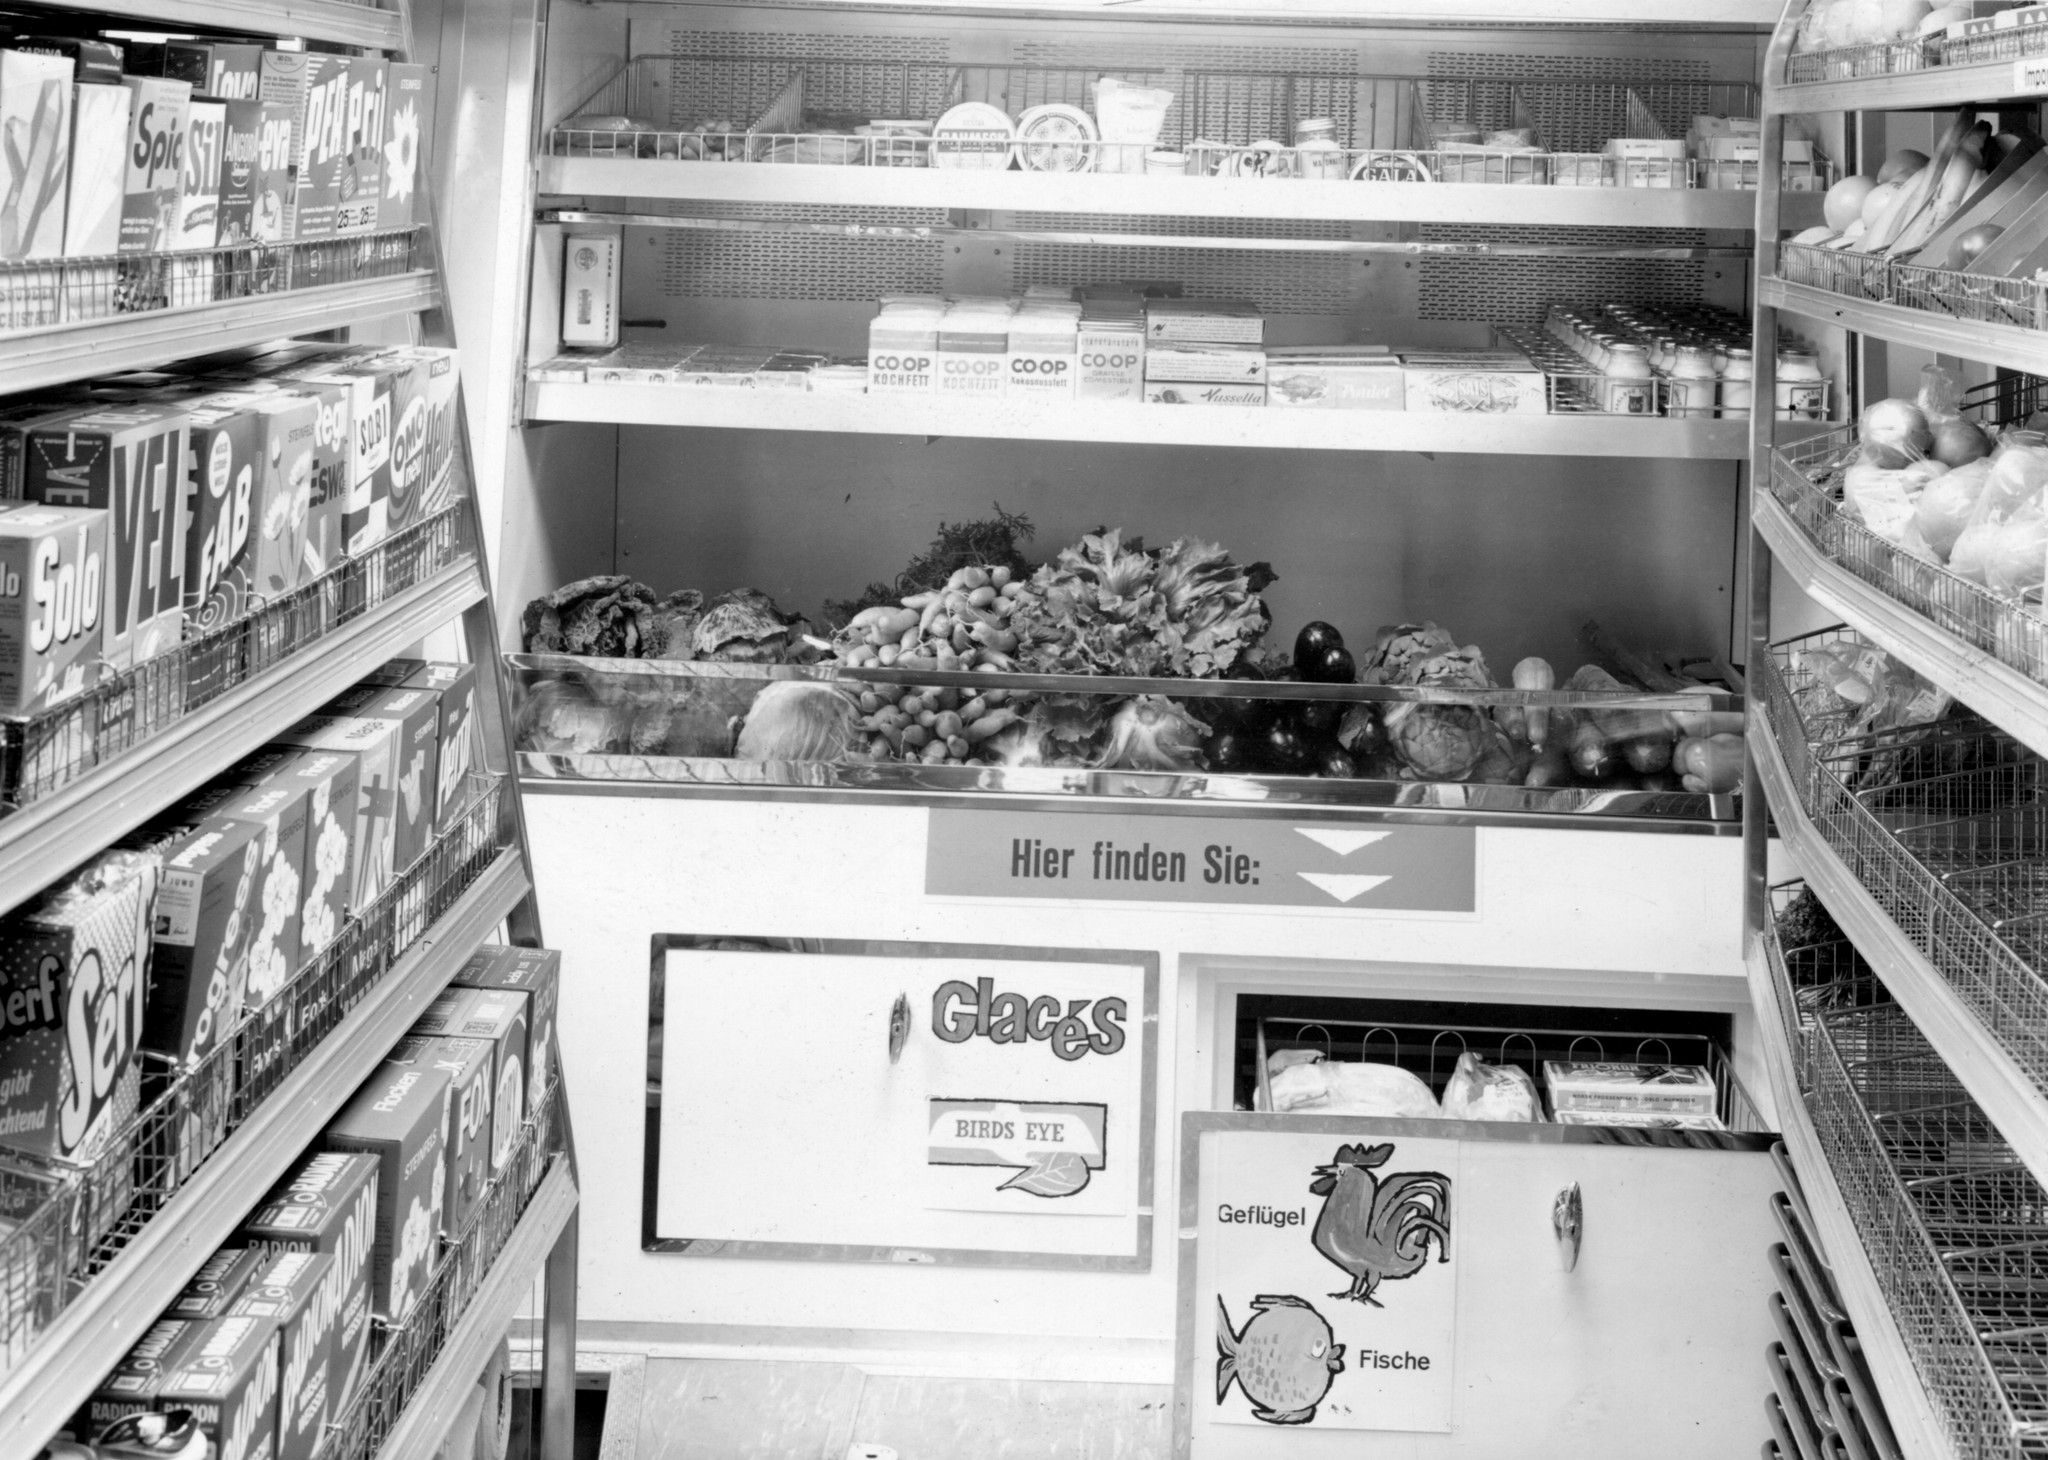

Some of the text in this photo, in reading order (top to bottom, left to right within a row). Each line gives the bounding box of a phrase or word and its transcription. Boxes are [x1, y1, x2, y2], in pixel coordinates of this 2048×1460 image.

[184, 118, 223, 197] Sil
[1362, 167, 1417, 182] GALA
[337, 210, 348, 229] 25
[360, 206, 370, 226] 25
[431, 356, 450, 374] neu
[873, 373, 930, 387] KOCHFETT
[943, 376, 999, 390] KOCHFETT
[1200, 387, 1263, 403] Nussella
[394, 401, 426, 473] OMO
[200, 463, 252, 612] FAB
[31, 522, 100, 654] Solo
[1011, 838, 1261, 886] Hier finden Sie:
[60, 864, 155, 1150] Serf
[931, 976, 1128, 1062] Glacés
[457, 1053, 493, 1159] FOX
[955, 1119, 1065, 1143] BIRDS EYE
[288, 1153, 351, 1192] RADION
[1218, 1203, 1306, 1229] Geflügel
[334, 1167, 379, 1317] ADION
[1359, 1349, 1431, 1370] Fische
